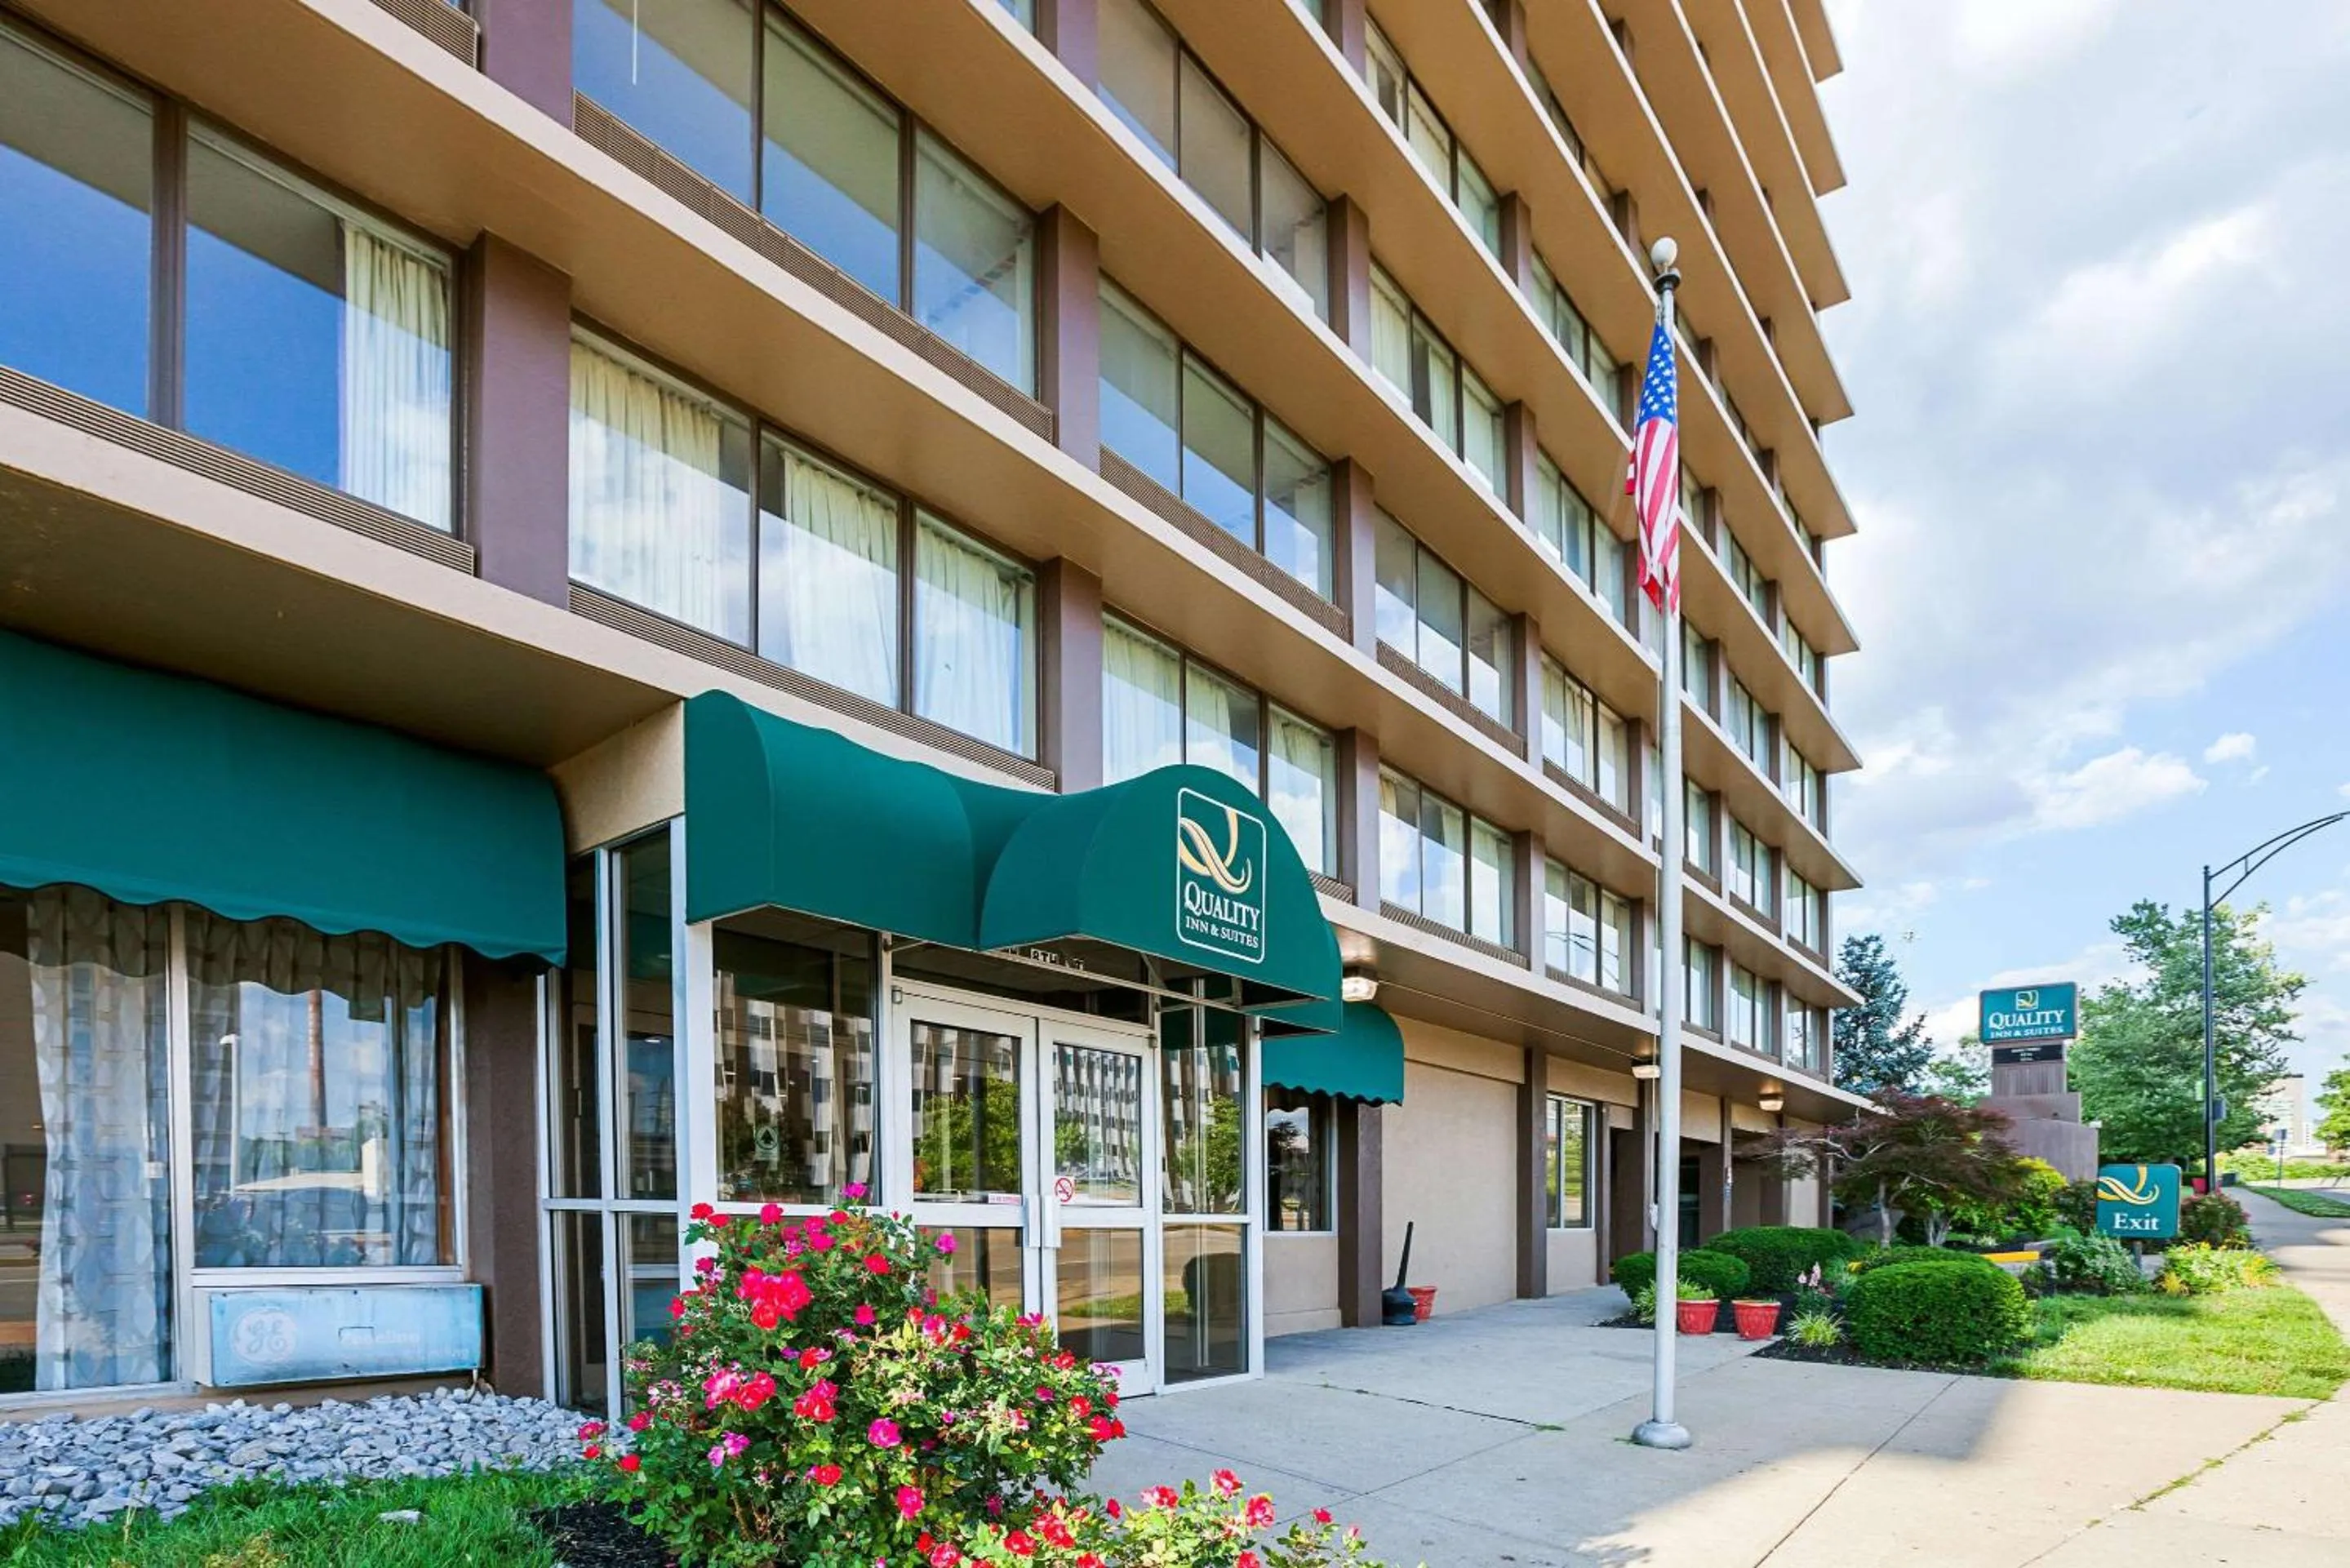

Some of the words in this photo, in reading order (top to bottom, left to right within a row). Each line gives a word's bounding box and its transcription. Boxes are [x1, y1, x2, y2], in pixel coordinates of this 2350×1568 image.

[1184, 881, 1260, 931] QUALITY
[1185, 916, 1209, 935] INN
[1211, 923, 1219, 937] &
[1220, 926, 1259, 948] SUITES
[1988, 1010, 2066, 1029] QUALITY
[1990, 1029, 2012, 1039] INN
[2013, 1029, 2022, 1037] &
[2023, 1026, 2064, 1037] SUITES
[2112, 1212, 2160, 1231] Exit
